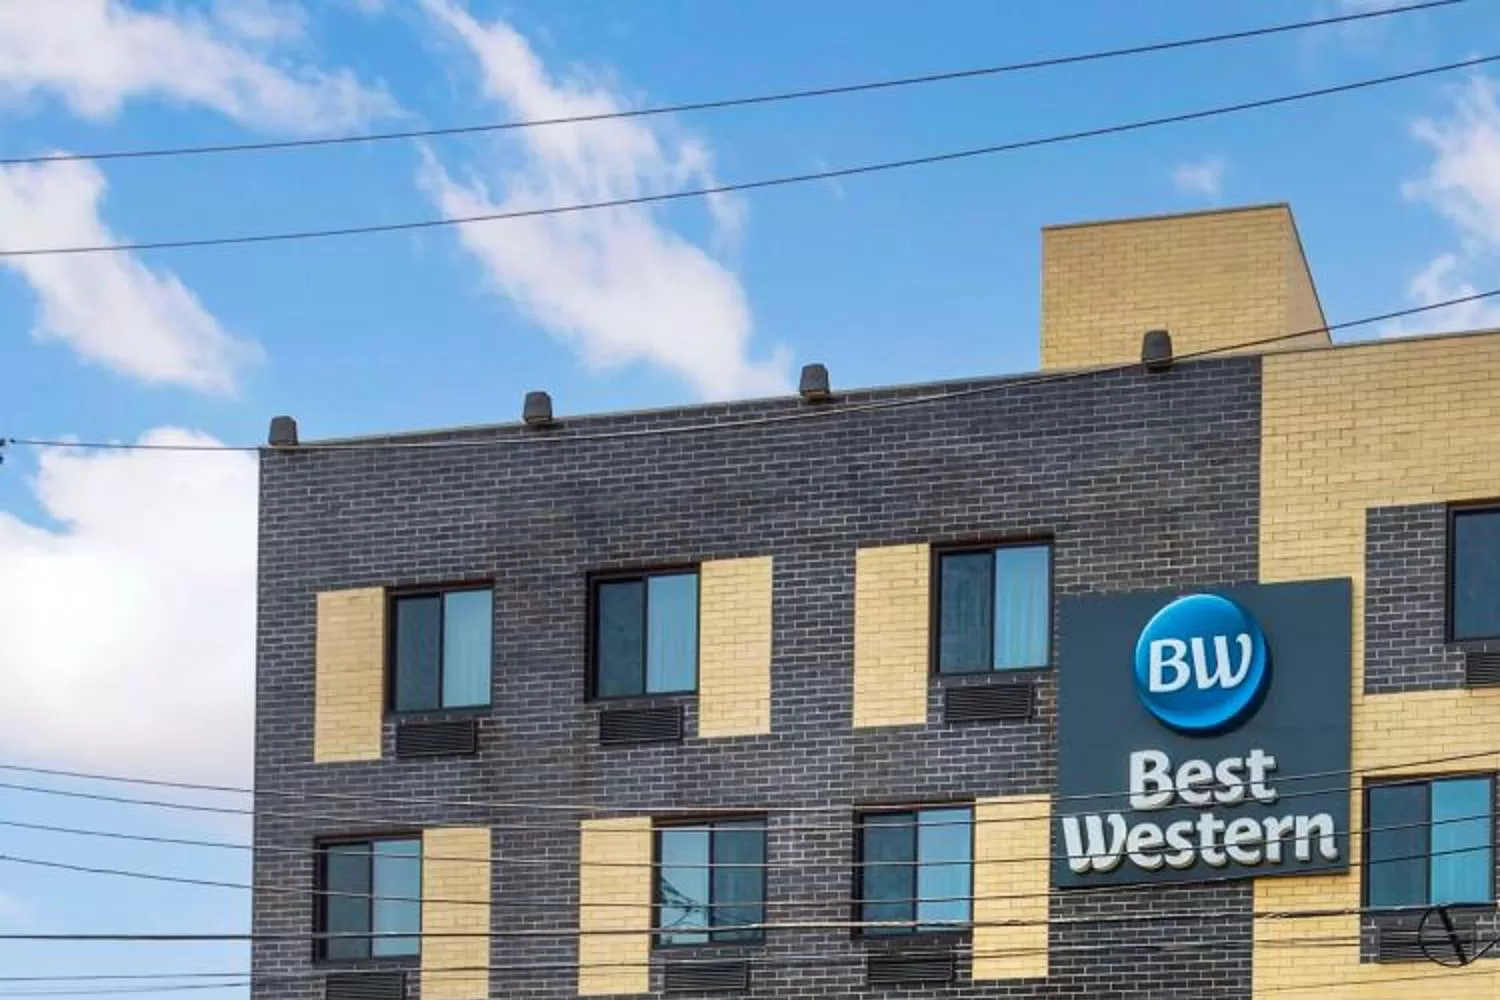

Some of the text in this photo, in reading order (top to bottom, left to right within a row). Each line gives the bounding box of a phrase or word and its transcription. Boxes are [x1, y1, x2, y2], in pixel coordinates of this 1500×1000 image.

[1149, 633, 1253, 693] BW
[1129, 749, 1277, 811] Best
[1062, 812, 1339, 873] Western
